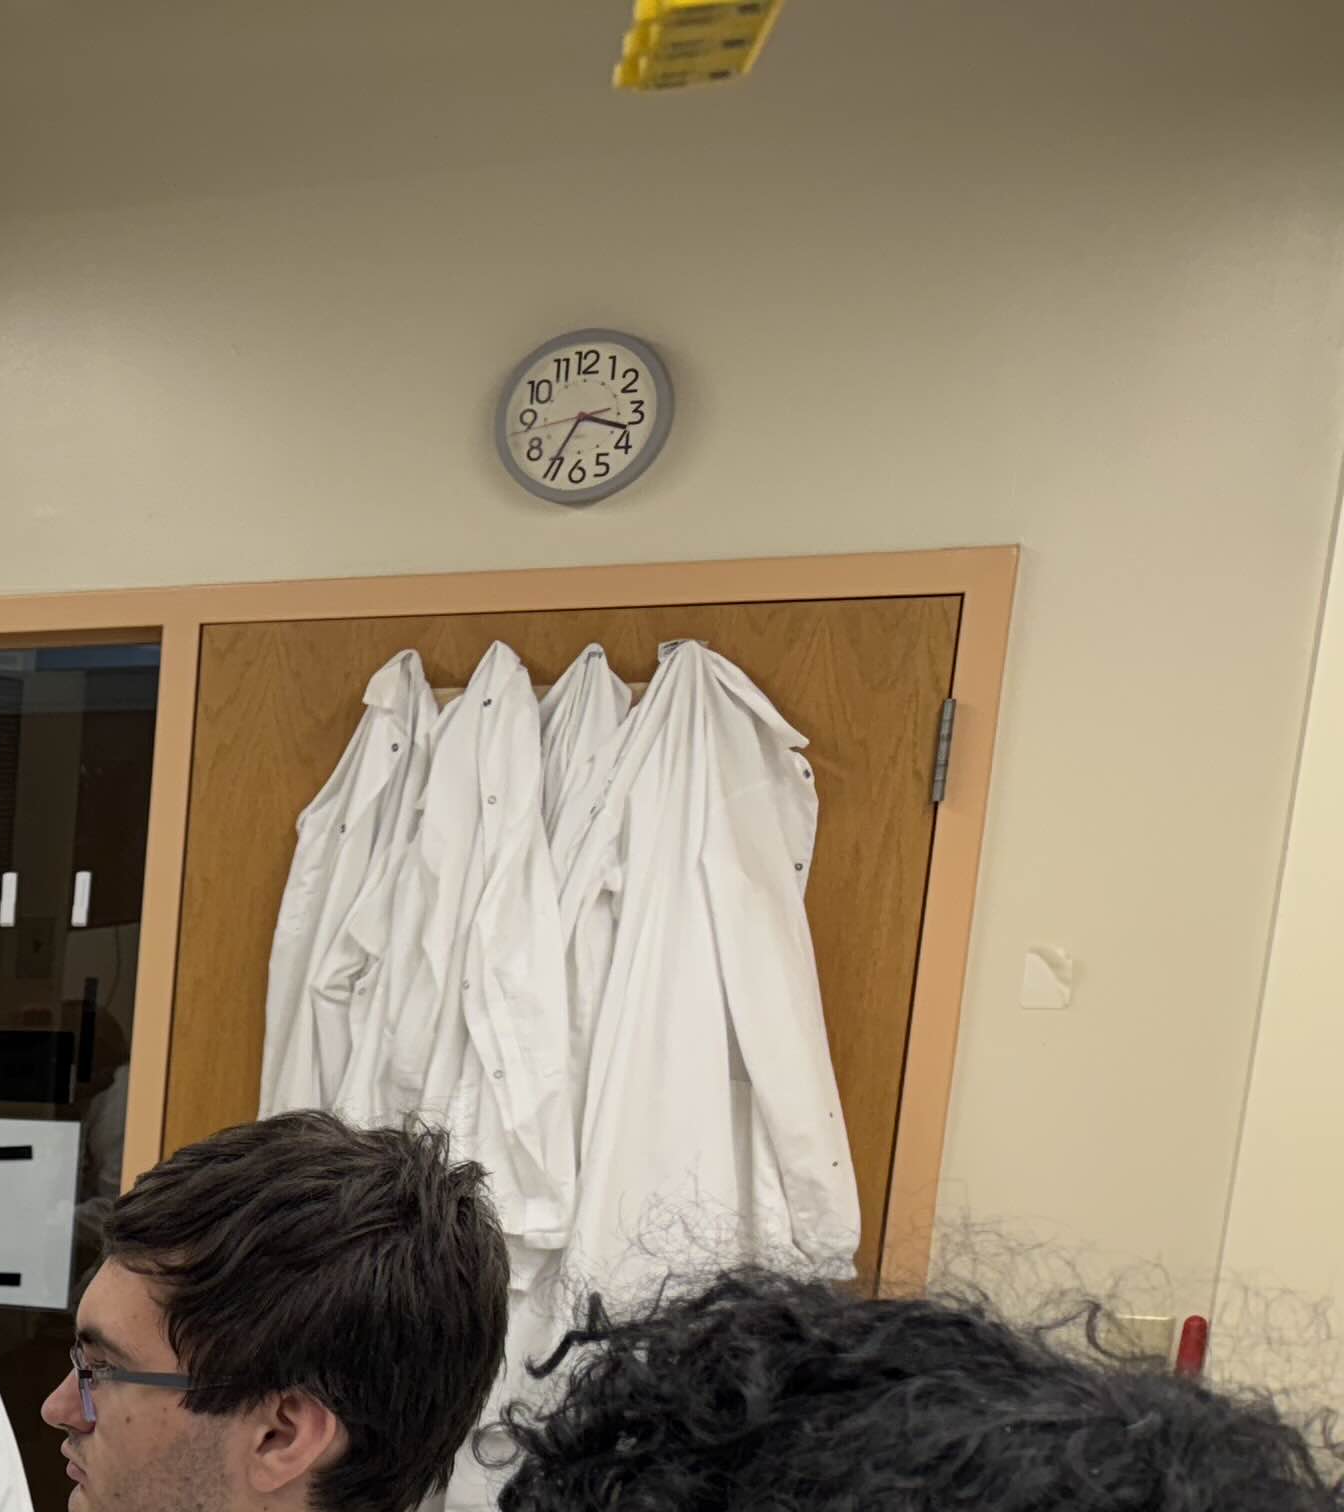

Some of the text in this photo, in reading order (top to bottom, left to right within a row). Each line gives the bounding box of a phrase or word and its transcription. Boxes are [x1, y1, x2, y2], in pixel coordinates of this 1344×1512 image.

[553, 358, 570, 383] 11
[575, 350, 600, 375] 12
[608, 355, 616, 380] 1
[527, 379, 553, 405] 10
[620, 368, 639, 393] 2
[519, 408, 538, 432] 9
[627, 400, 645, 425] 3
[526, 437, 543, 462] 8
[614, 429, 632, 454] 4
[549, 457, 564, 481] 7
[568, 459, 586, 483] 6
[593, 453, 610, 477] 5
